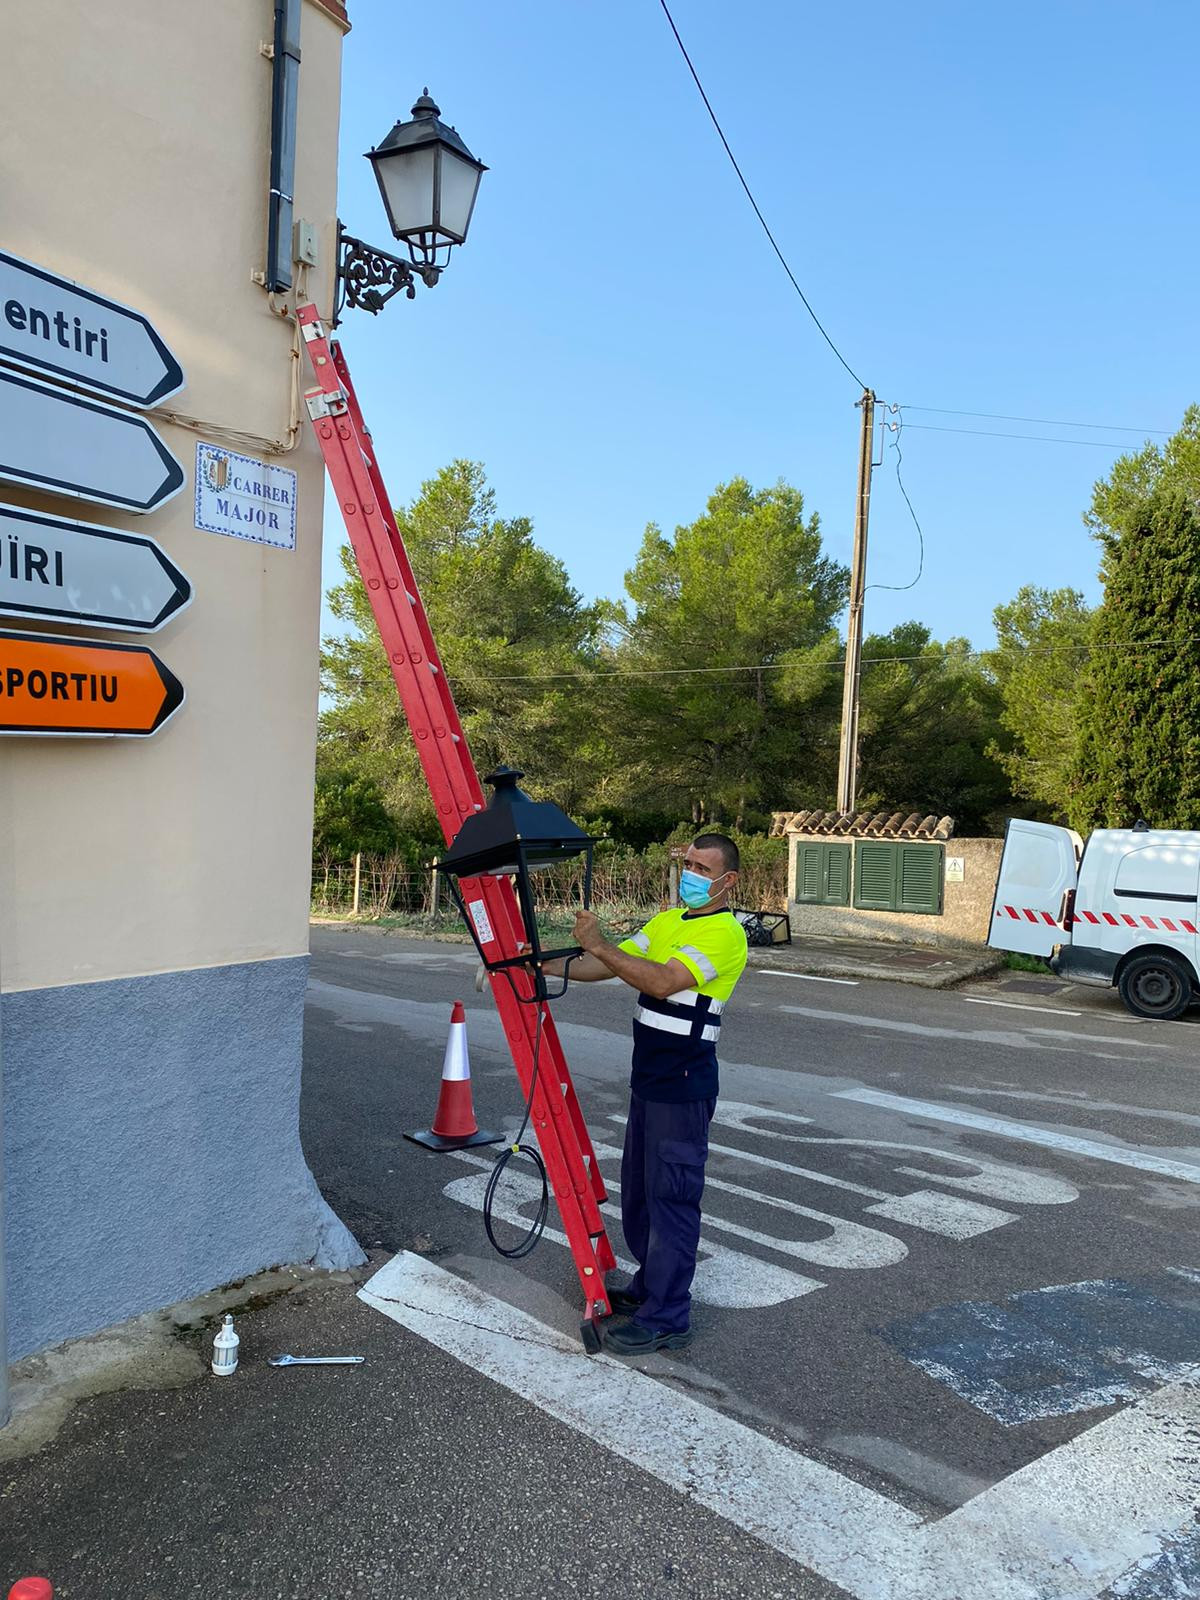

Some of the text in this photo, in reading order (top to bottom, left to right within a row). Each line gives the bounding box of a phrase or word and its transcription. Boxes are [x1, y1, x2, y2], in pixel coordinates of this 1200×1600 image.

[233, 477, 290, 504] CARRER
[216, 498, 280, 529] MAJOR
[0, 534, 64, 587] ÏRI
[0, 667, 118, 703] PORTIU
